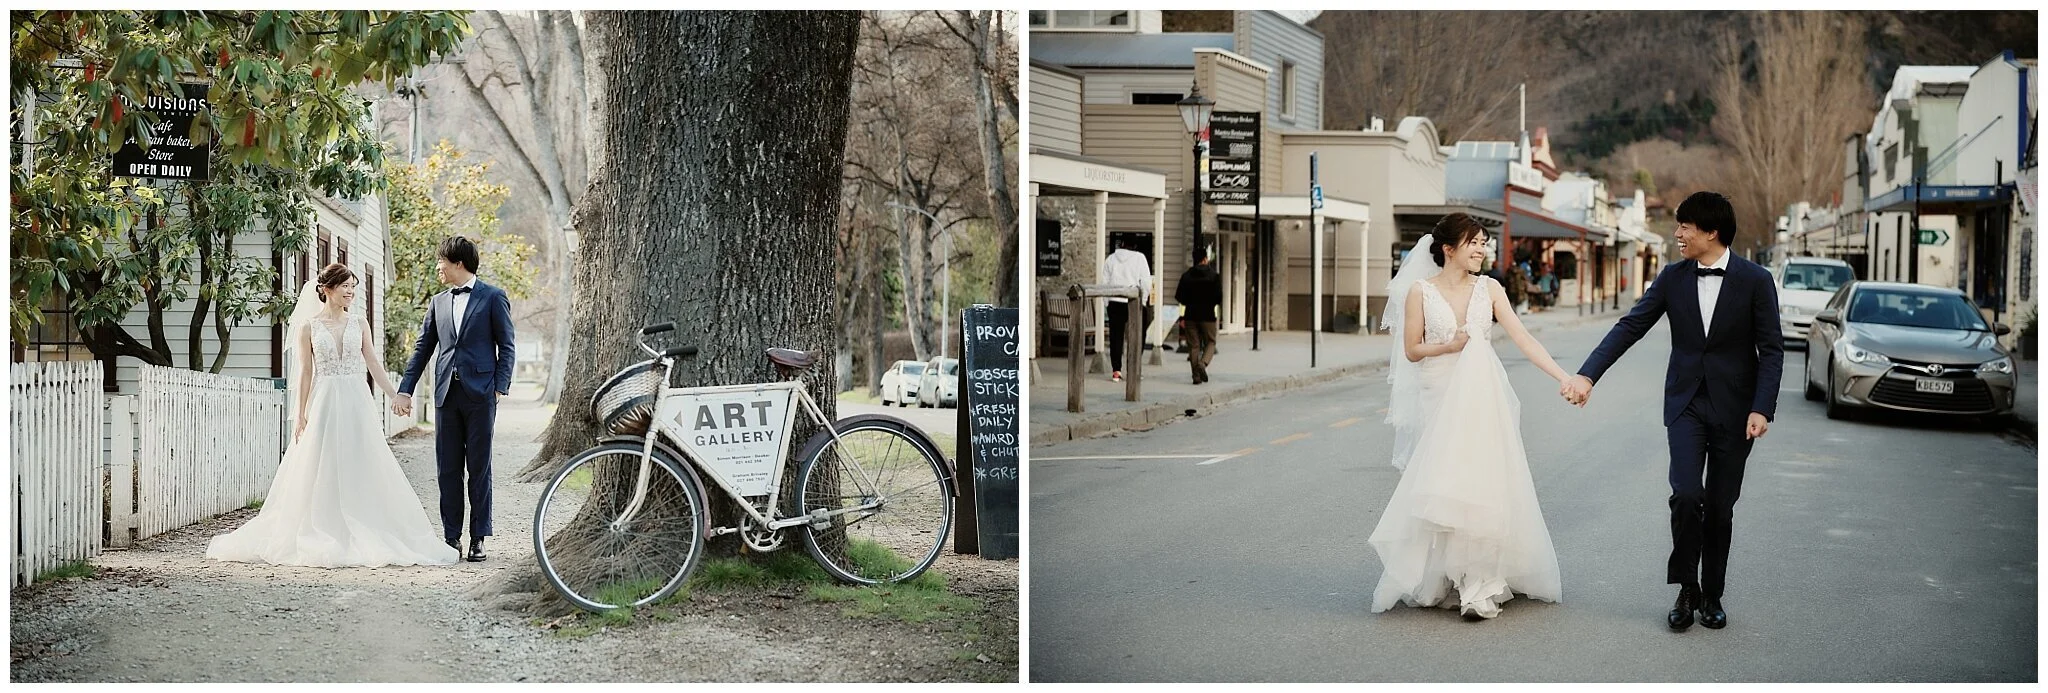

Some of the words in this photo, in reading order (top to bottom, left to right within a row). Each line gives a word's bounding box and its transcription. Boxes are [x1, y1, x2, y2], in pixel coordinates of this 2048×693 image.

[151, 120, 174, 133] Cafe
[125, 135, 164, 146] Asan
[148, 148, 174, 160] Store
[129, 163, 157, 176] OPEN
[161, 164, 192, 177] DAILY
[975, 382, 1019, 398] STICK
[694, 401, 772, 430] ART
[976, 403, 1016, 415] FRESH
[978, 416, 1013, 429] DAILY
[695, 430, 774, 446] GALLERY
[979, 432, 1014, 445] AWARD
